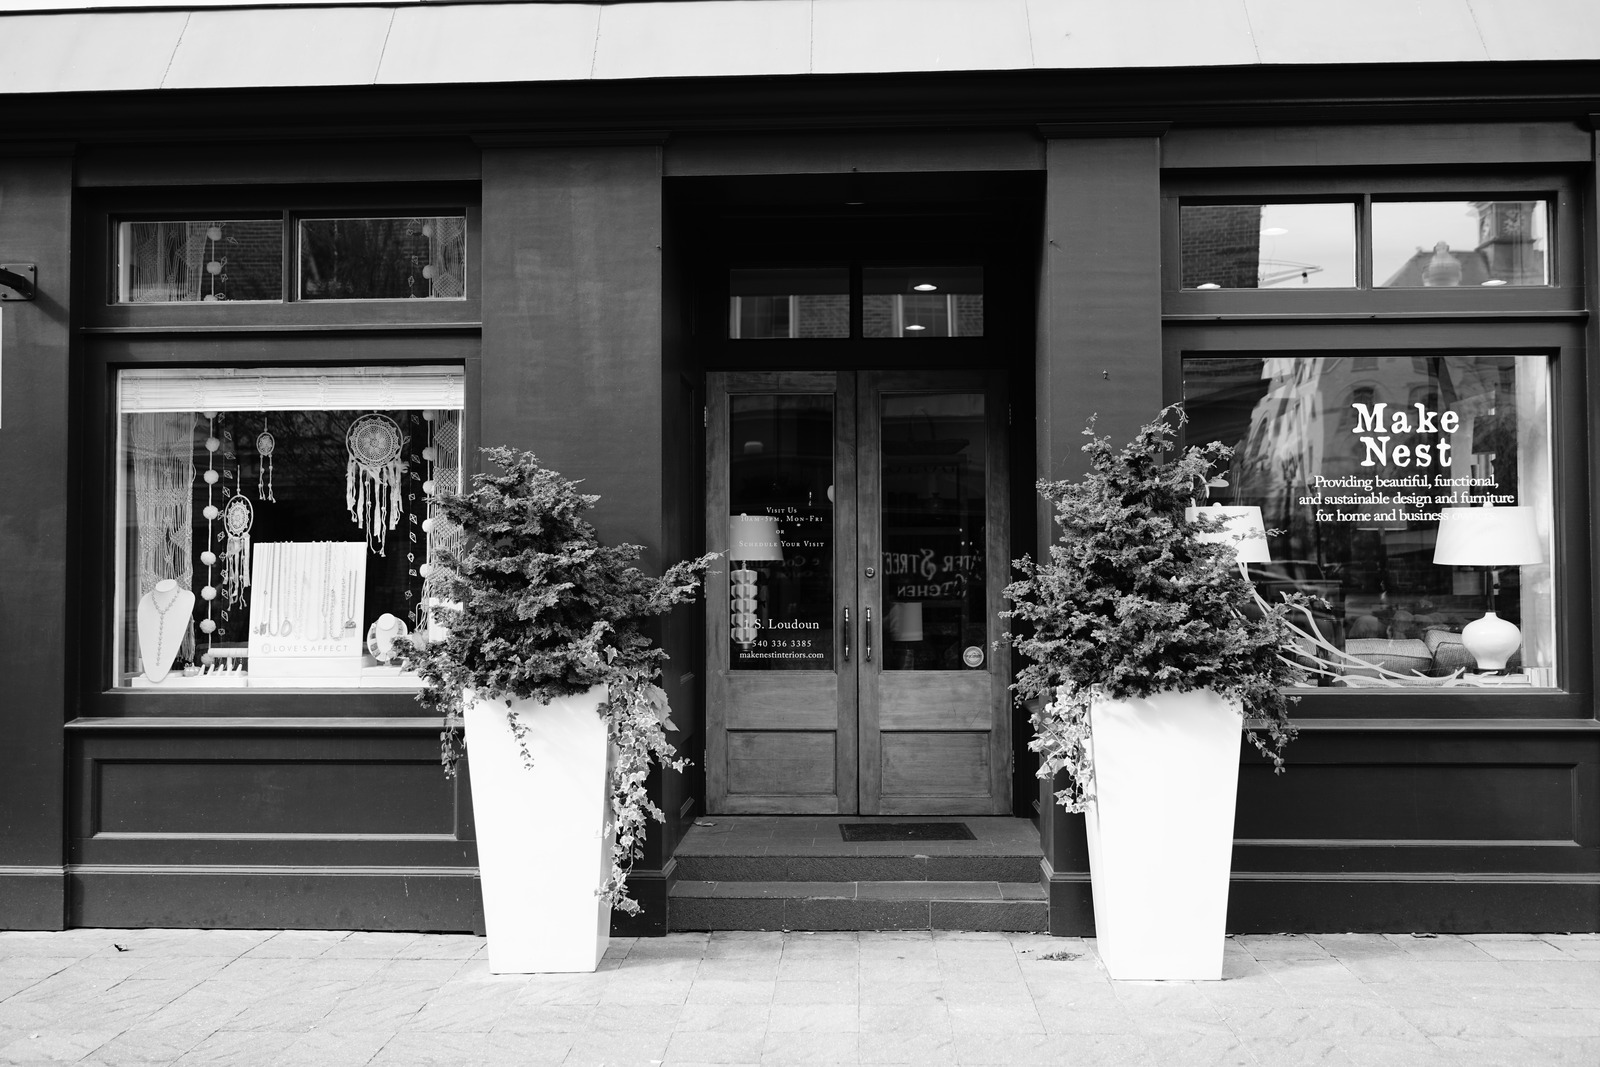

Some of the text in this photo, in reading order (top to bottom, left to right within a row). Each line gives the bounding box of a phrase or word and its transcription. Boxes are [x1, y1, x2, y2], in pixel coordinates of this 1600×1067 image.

[1352, 402, 1459, 434] Make
[1359, 436, 1452, 467] Nest
[1314, 474, 1499, 491] Providing beautiful, functional,
[1299, 491, 1515, 508] and sustainable design and furniture
[1316, 508, 1334, 522] for
[1336, 508, 1371, 522] home
[1373, 508, 1396, 522] and
[1399, 508, 1449, 522] business
[754, 618, 765, 629] S.
[768, 618, 820, 630] Loudoun
[739, 651, 824, 659] makenestinteriors.com
